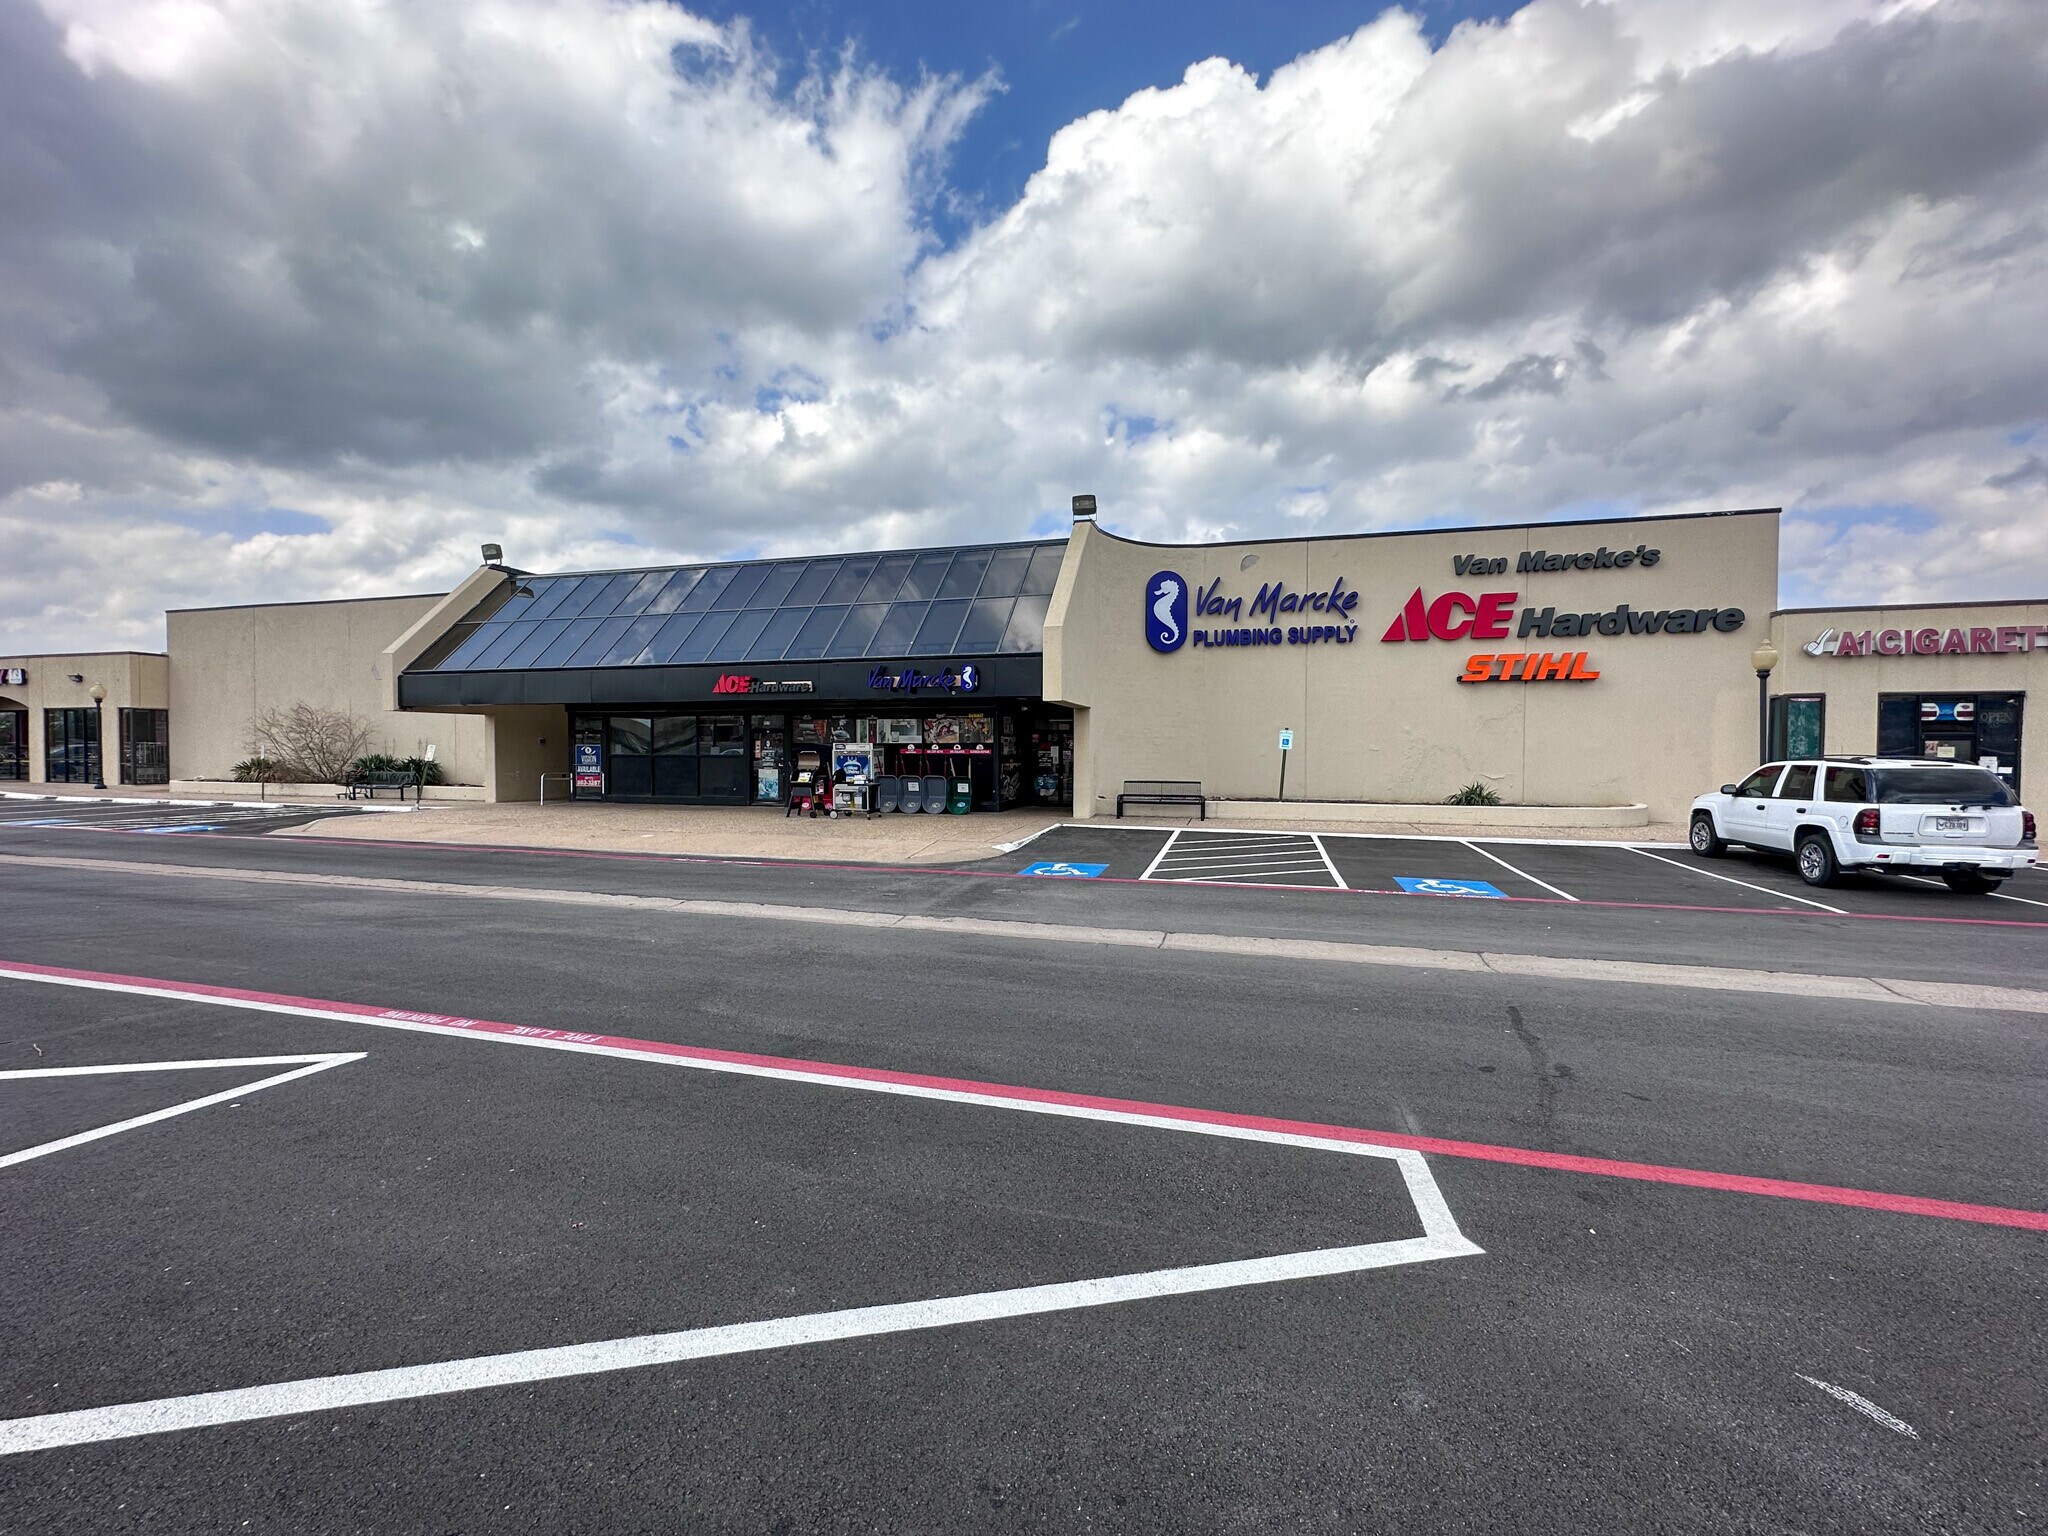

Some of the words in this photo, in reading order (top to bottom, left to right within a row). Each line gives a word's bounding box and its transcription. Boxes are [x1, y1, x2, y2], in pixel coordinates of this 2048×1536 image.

[1453, 554, 1507, 576] Van
[1516, 544, 1661, 572] Marcke's
[1196, 576, 1242, 621] Van
[1249, 576, 1359, 624] Marcke
[1380, 586, 1519, 642] ACE
[1517, 604, 1746, 639] Hardware
[1193, 627, 1283, 648] PLUMBING
[1287, 624, 1358, 645] SUPPLY
[1832, 630, 1873, 656] A1
[1876, 625, 2048, 655] CIGARET
[866, 664, 892, 693] Van
[896, 666, 956, 695] Marcke
[1460, 652, 1601, 682] STIHL
[712, 673, 751, 694] ACE
[750, 680, 813, 694] Hardware
[504, 1026, 558, 1037] LANE
[555, 1032, 603, 1043] FIRE
